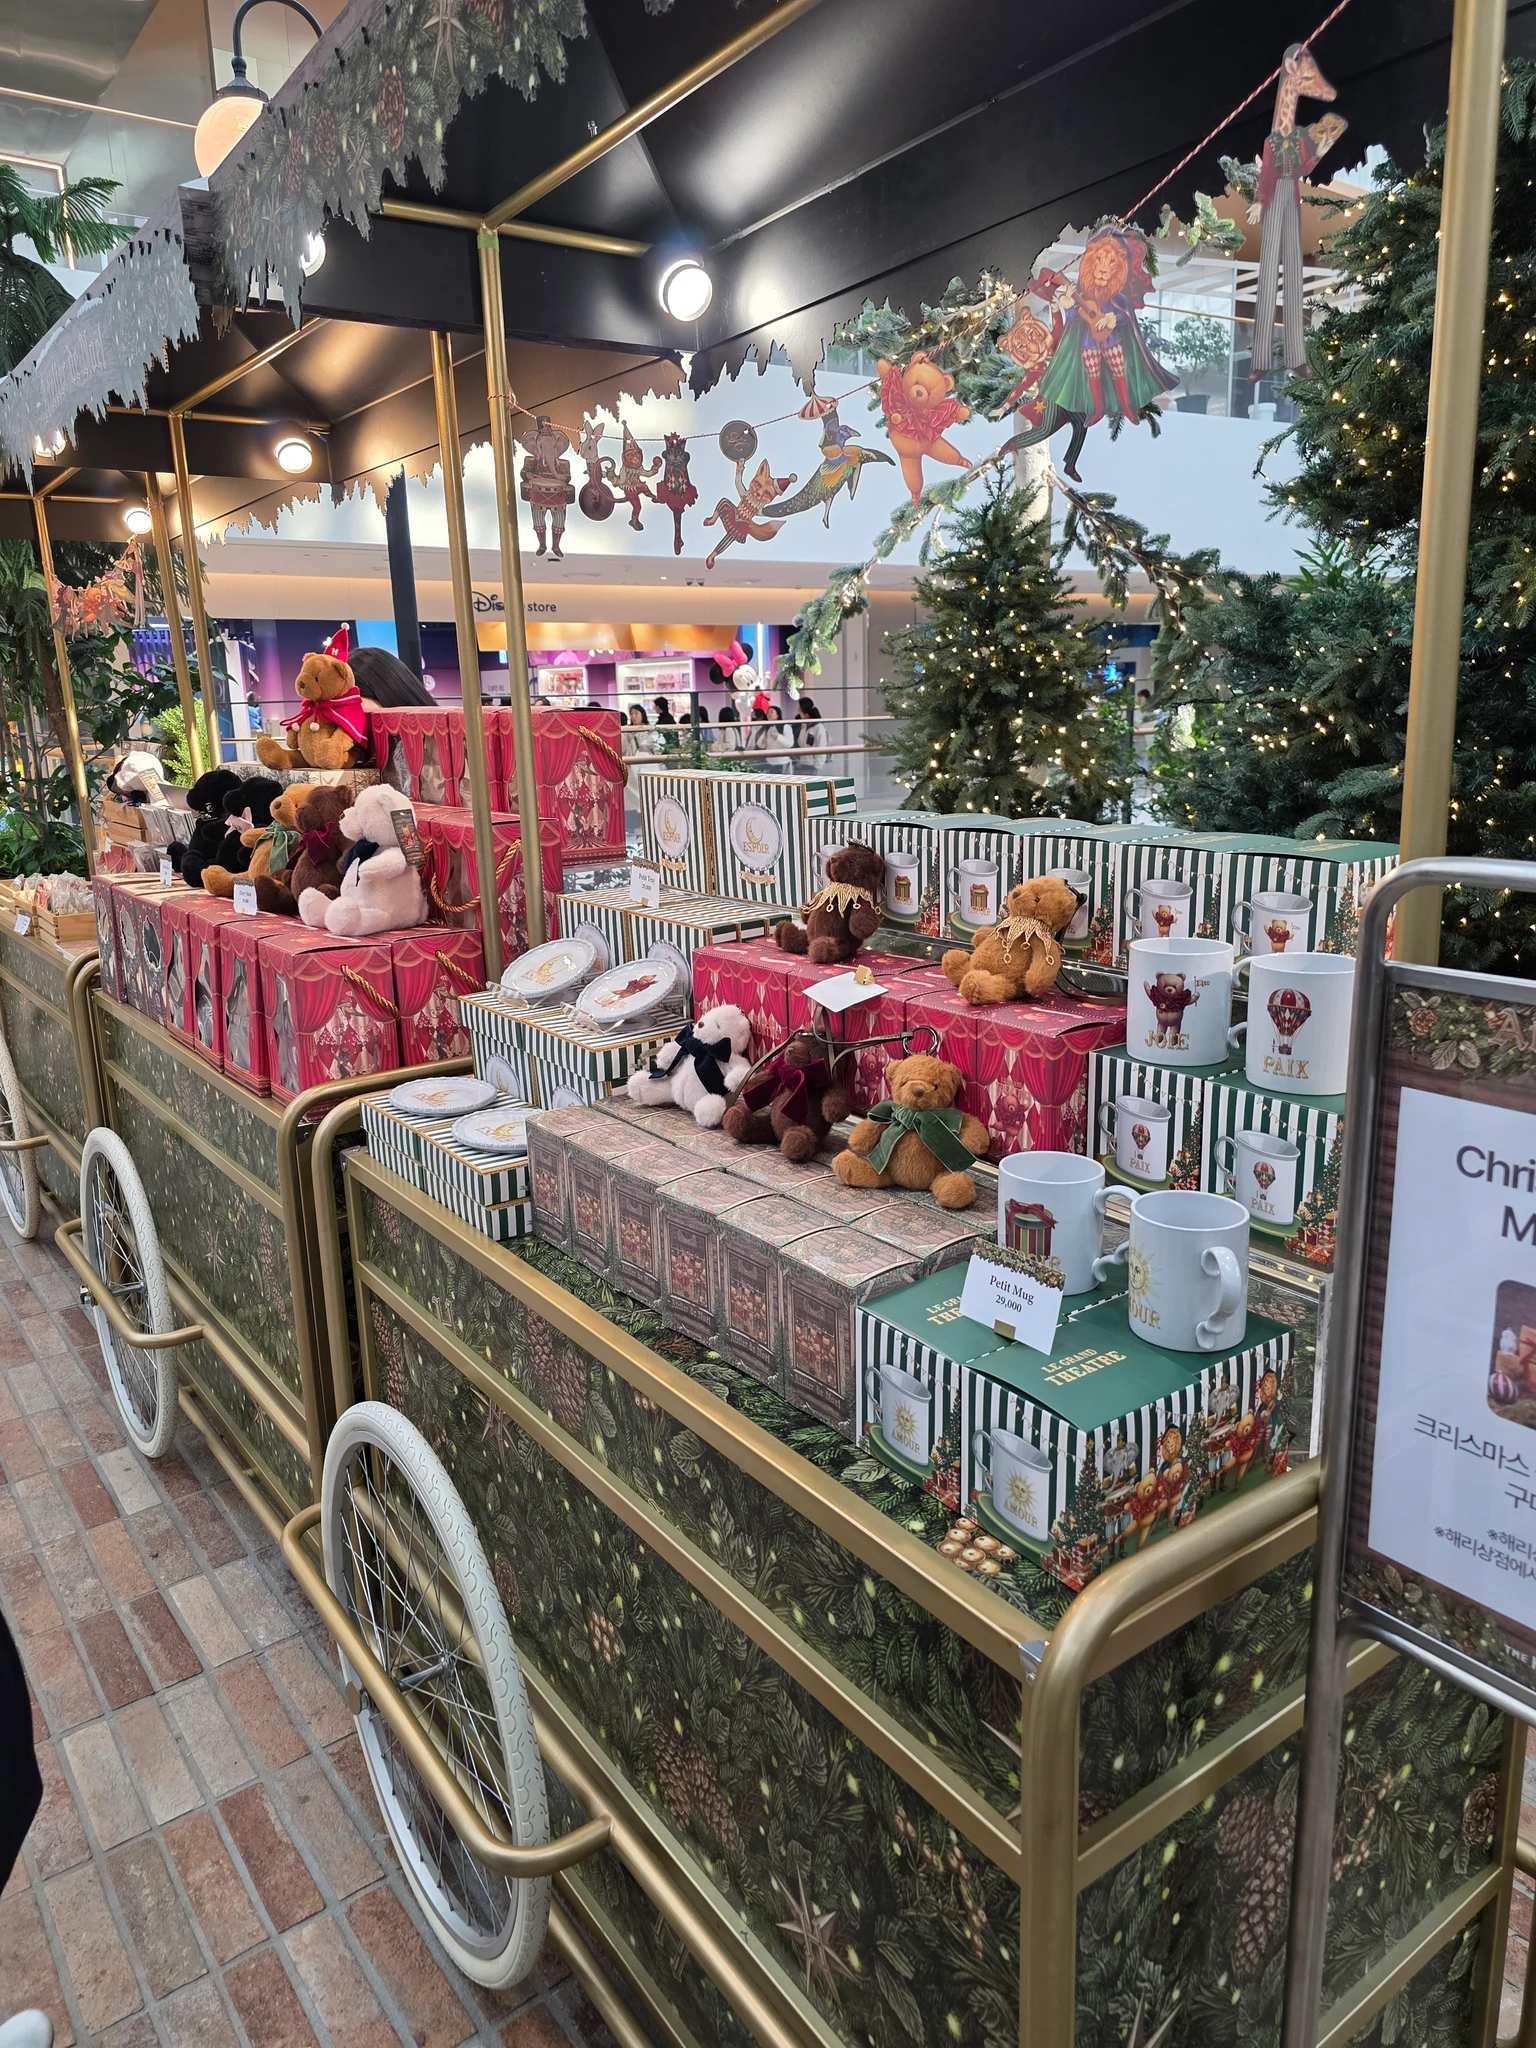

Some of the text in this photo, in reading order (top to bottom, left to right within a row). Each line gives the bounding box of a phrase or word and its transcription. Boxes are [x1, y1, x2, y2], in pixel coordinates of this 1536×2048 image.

[527, 602, 557, 612] store
[743, 841, 770, 855] ESPOIR
[1144, 1030, 1190, 1051] JOIE
[1262, 1054, 1310, 1080] PAIX
[1129, 1156, 1151, 1174] PAIX
[1456, 1145, 1536, 1193] Chri
[1250, 1196, 1276, 1216] PAIX
[989, 1274, 1035, 1306] Petit Mug
[925, 1302, 945, 1315] LE
[995, 1293, 1023, 1314] 29,000
[1041, 1348, 1098, 1374] LE GRAND
[1043, 1350, 1128, 1387] THEATRE
[890, 1428, 921, 1456] AMOUR
[1414, 1412, 1531, 1478] 크리스마스
[1003, 1501, 1039, 1530] AMOUR
[1504, 1644, 1528, 1664] THE
